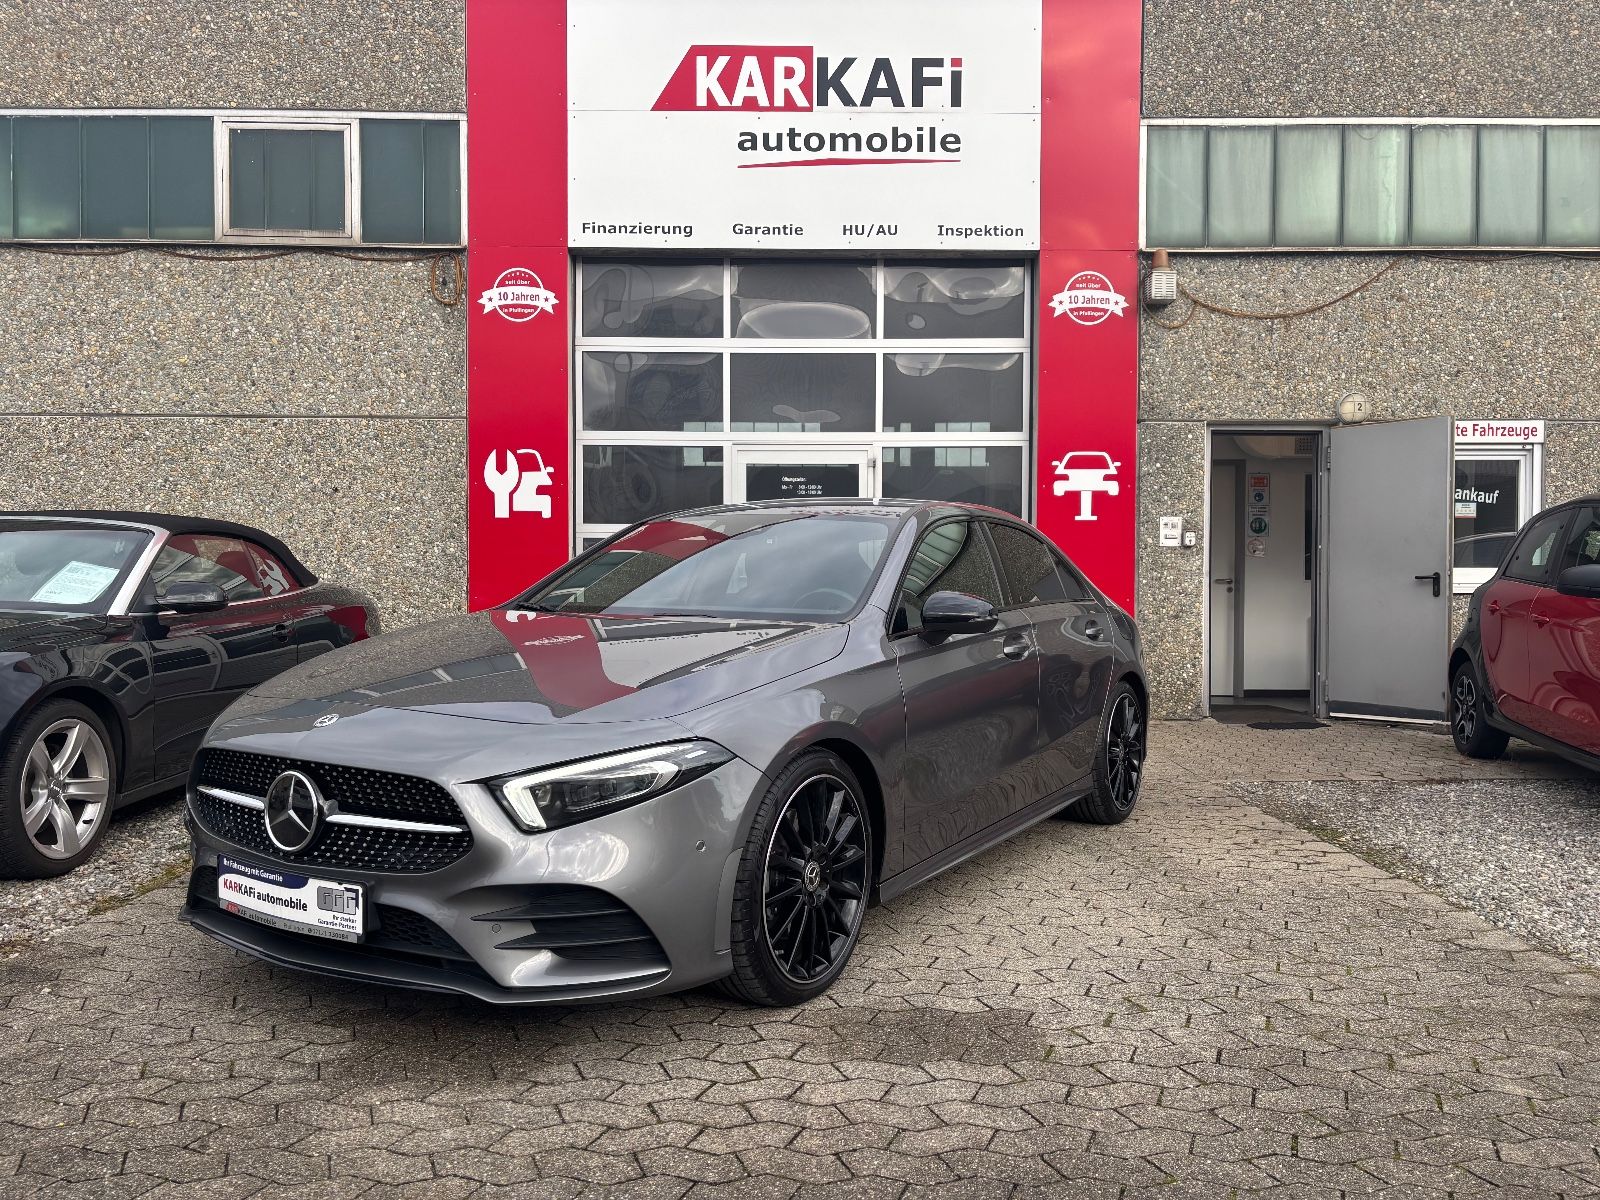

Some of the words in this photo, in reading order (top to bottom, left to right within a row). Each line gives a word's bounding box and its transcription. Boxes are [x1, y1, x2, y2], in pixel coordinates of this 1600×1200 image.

[695, 55, 962, 108] KARKAFi
[737, 126, 961, 153] automobile
[581, 222, 694, 239] Finanzierung
[732, 223, 804, 236] Garantie
[842, 224, 899, 237] HU/AU
[937, 225, 1025, 239] Inspektion
[498, 291, 509, 302] 10
[511, 291, 540, 302] Jahren
[1068, 295, 1079, 305] 10
[1081, 295, 1111, 305] Jahren
[1357, 402, 1363, 412] 2
[1472, 423, 1538, 440] Fahrzeuge
[1455, 487, 1500, 504] ankauf
[229, 860, 252, 875] Fahrzeug
[251, 867, 260, 877] mit
[260, 869, 284, 882] Garantie
[223, 877, 256, 899] KARKAFi
[256, 891, 308, 912] automobile
